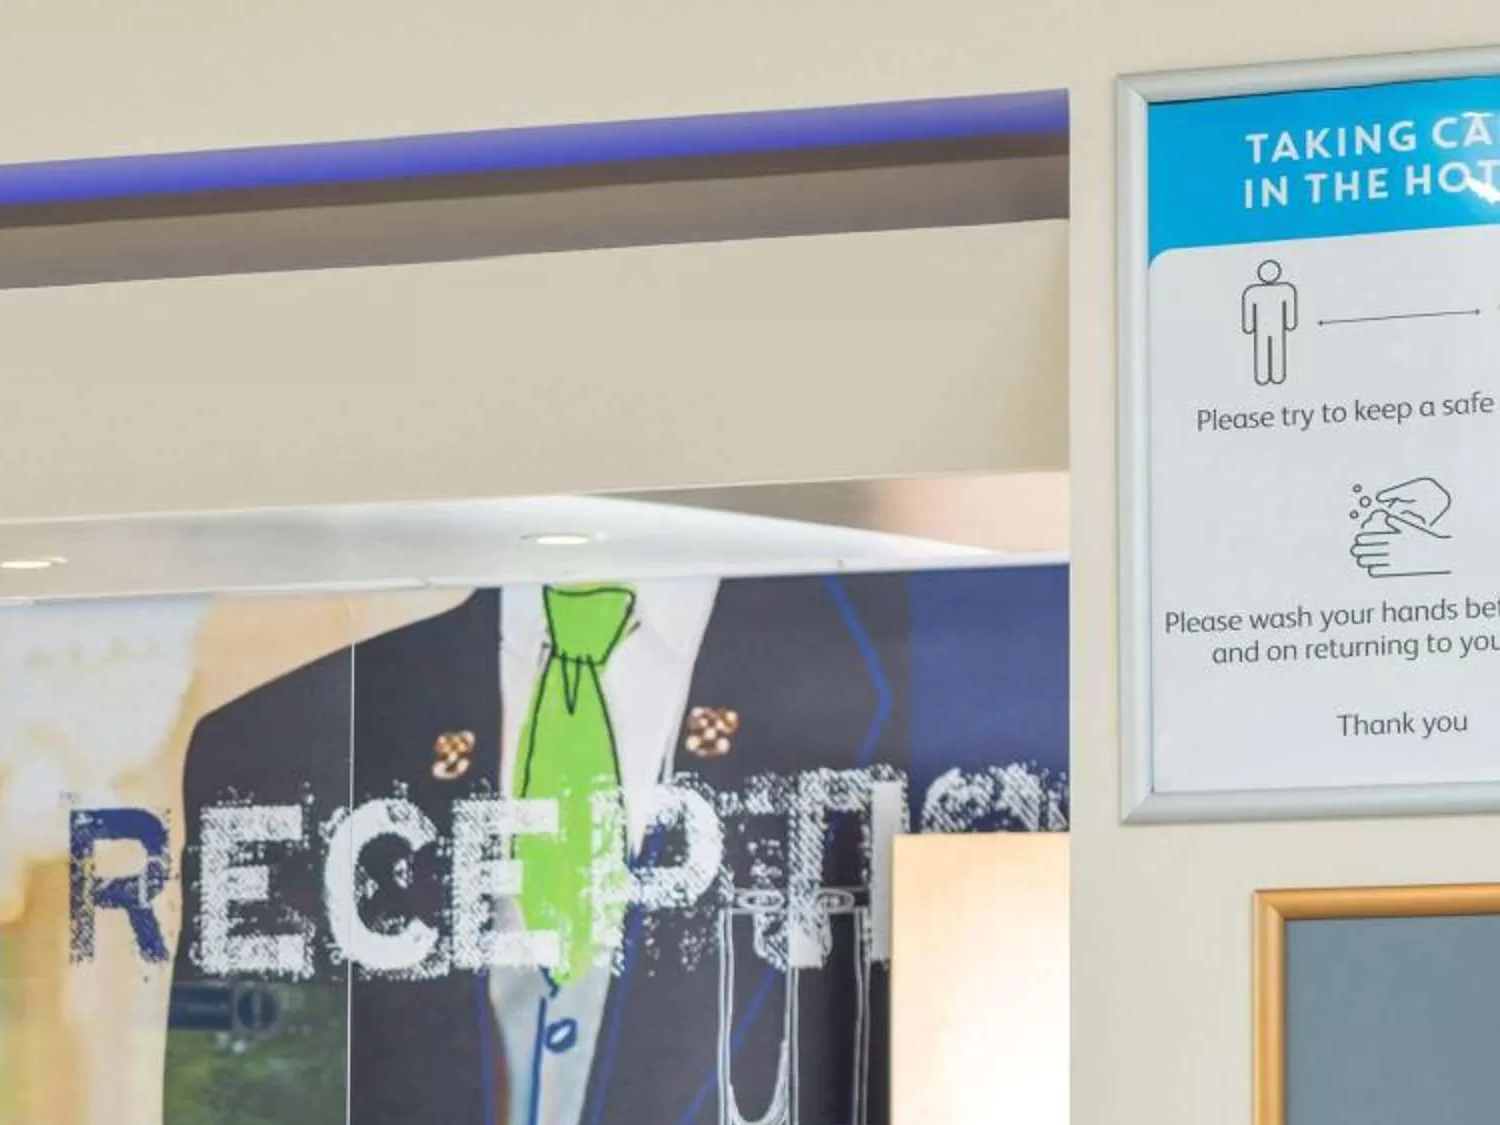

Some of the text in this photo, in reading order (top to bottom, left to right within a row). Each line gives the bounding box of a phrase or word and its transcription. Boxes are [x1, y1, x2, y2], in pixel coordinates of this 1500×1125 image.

[1244, 111, 1500, 164] TAKING CA
[1244, 175, 1289, 209] IN
[1304, 167, 1389, 204] THE
[1197, 390, 1494, 432] Please try to keep a safe
[1164, 595, 1500, 634] Please wash your hands be
[1211, 640, 1260, 664] and
[1266, 642, 1298, 661] on
[1304, 634, 1420, 661] returning
[1426, 632, 1453, 654] to
[1336, 711, 1469, 740] Thank you
[67, 764, 1070, 982] RECEPTI
